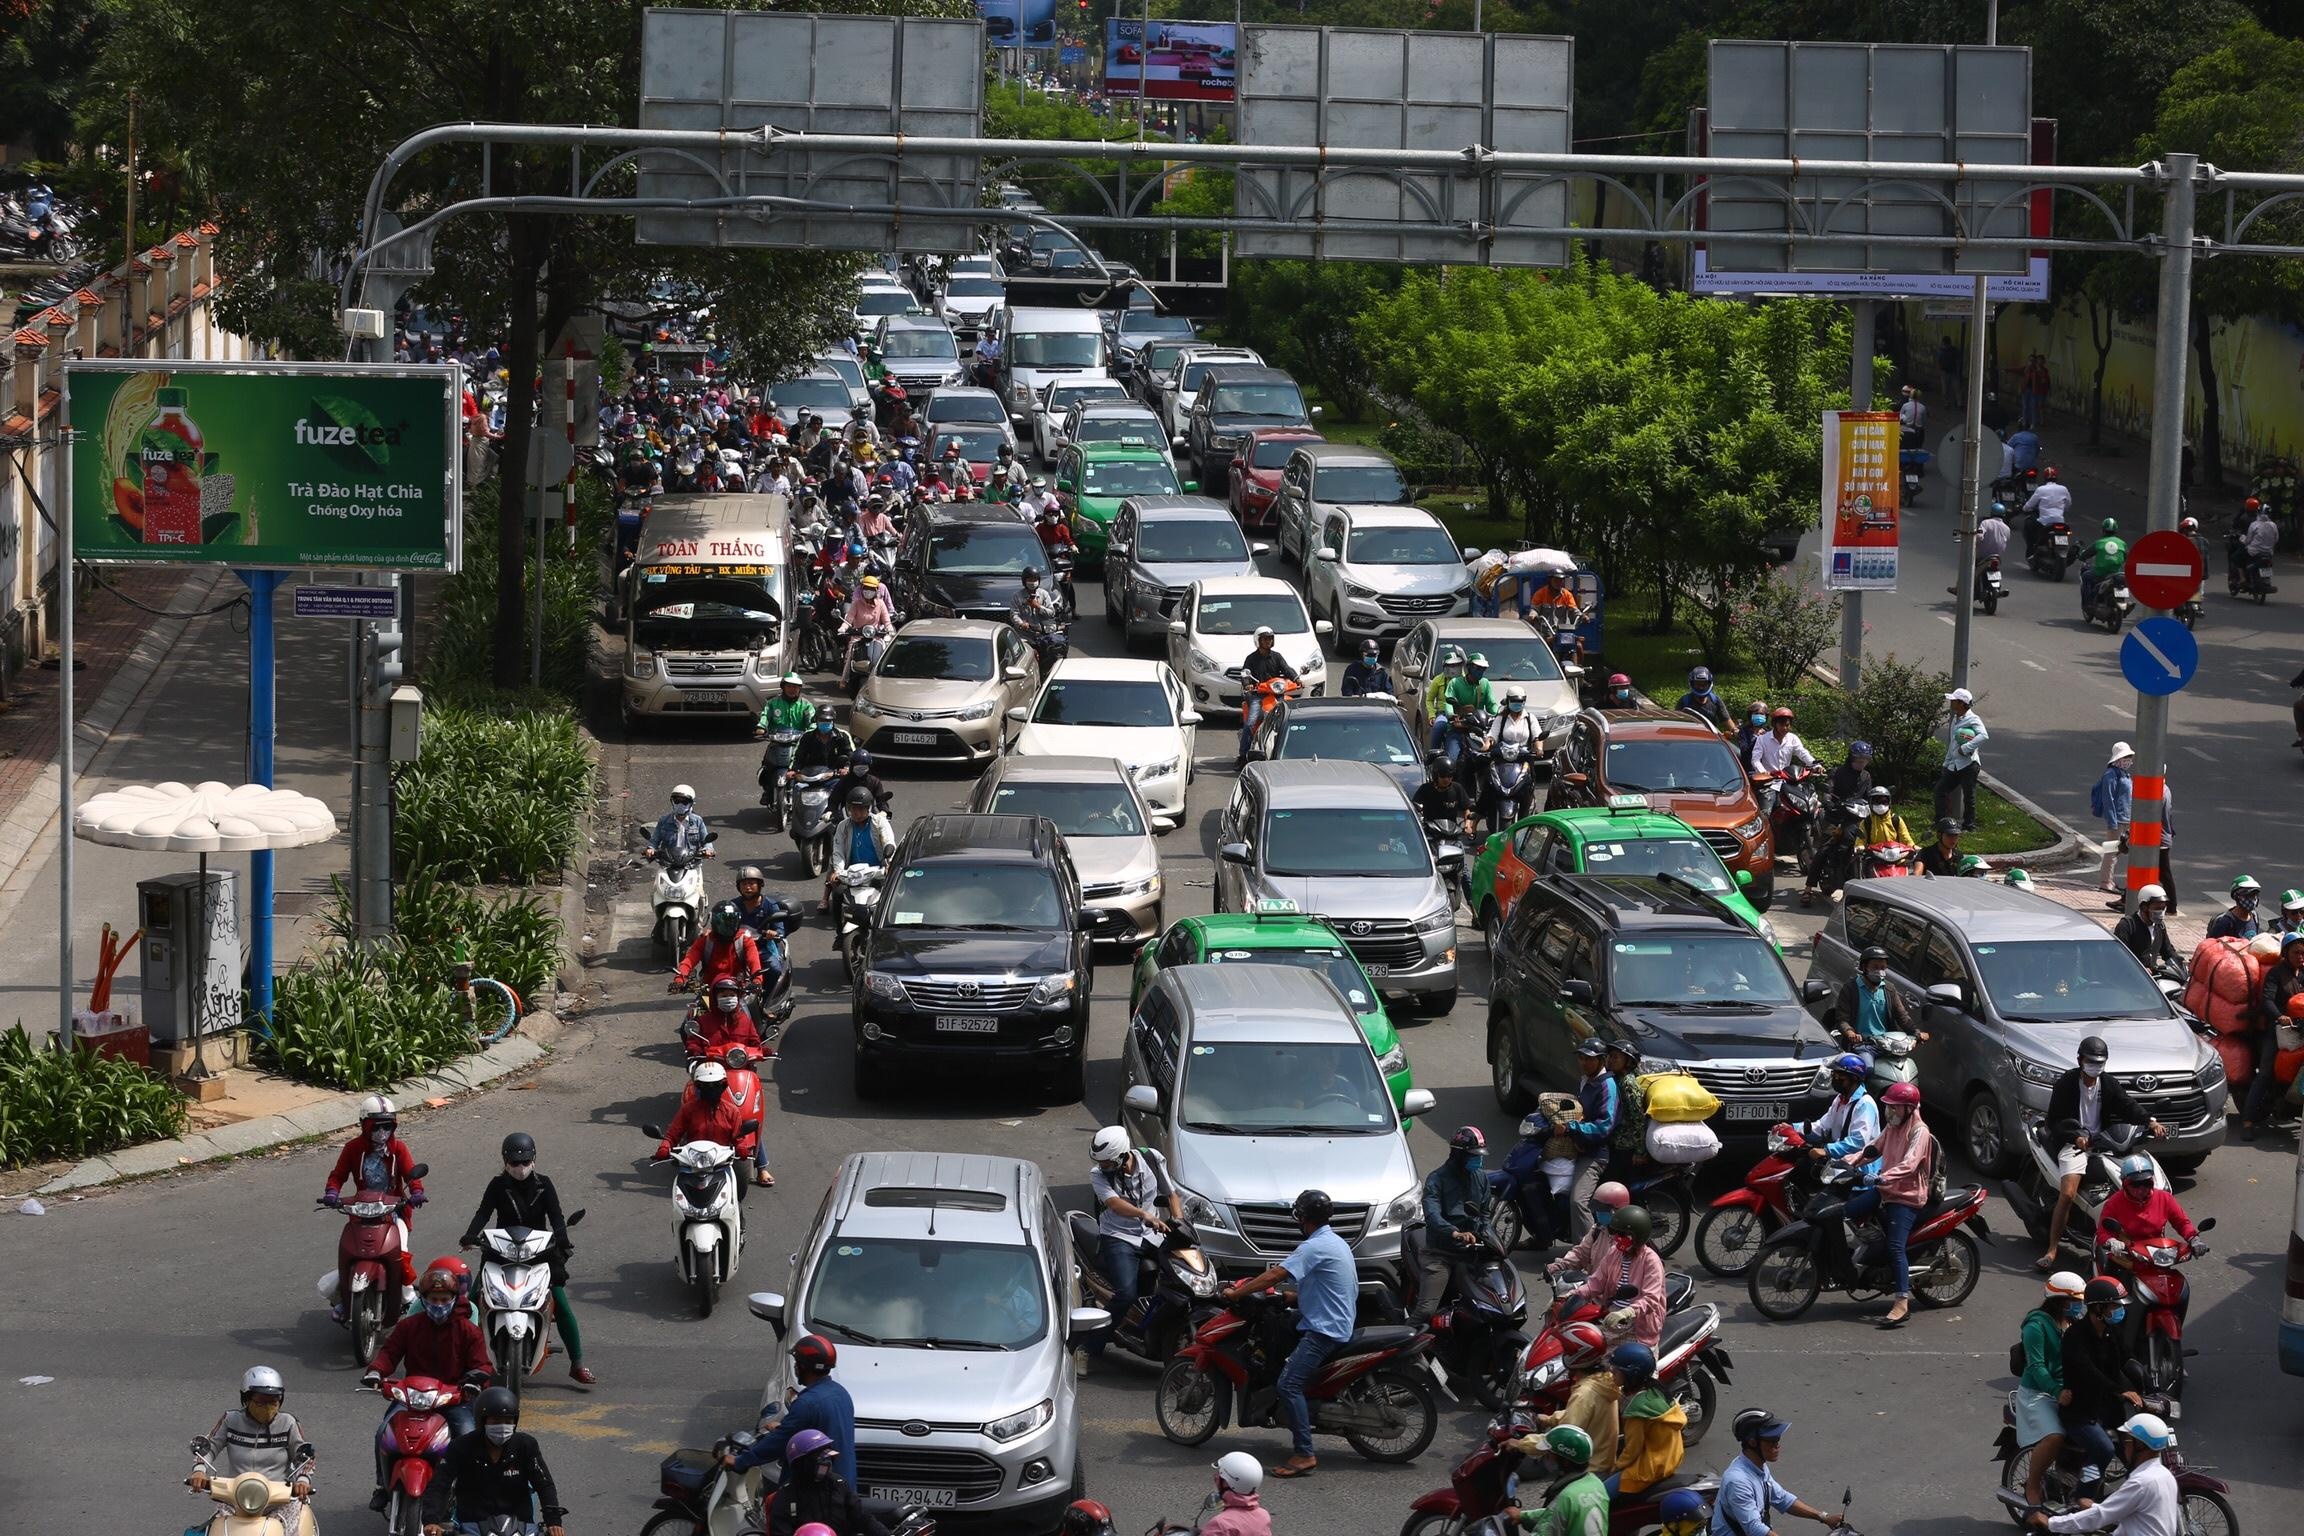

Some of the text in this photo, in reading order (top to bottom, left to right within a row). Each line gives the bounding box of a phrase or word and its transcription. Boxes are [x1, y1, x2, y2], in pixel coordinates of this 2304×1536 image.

[288, 483, 423, 502] Trà Đào Hạt Chia
[308, 503, 403, 519] Chống Oxy hóa
[657, 537, 764, 557] TOÀN THẮNG
[684, 563, 701, 575] TÀU
[937, 1018, 996, 1031] 51F-525.22
[1557, 1443, 1577, 1457] Grab
